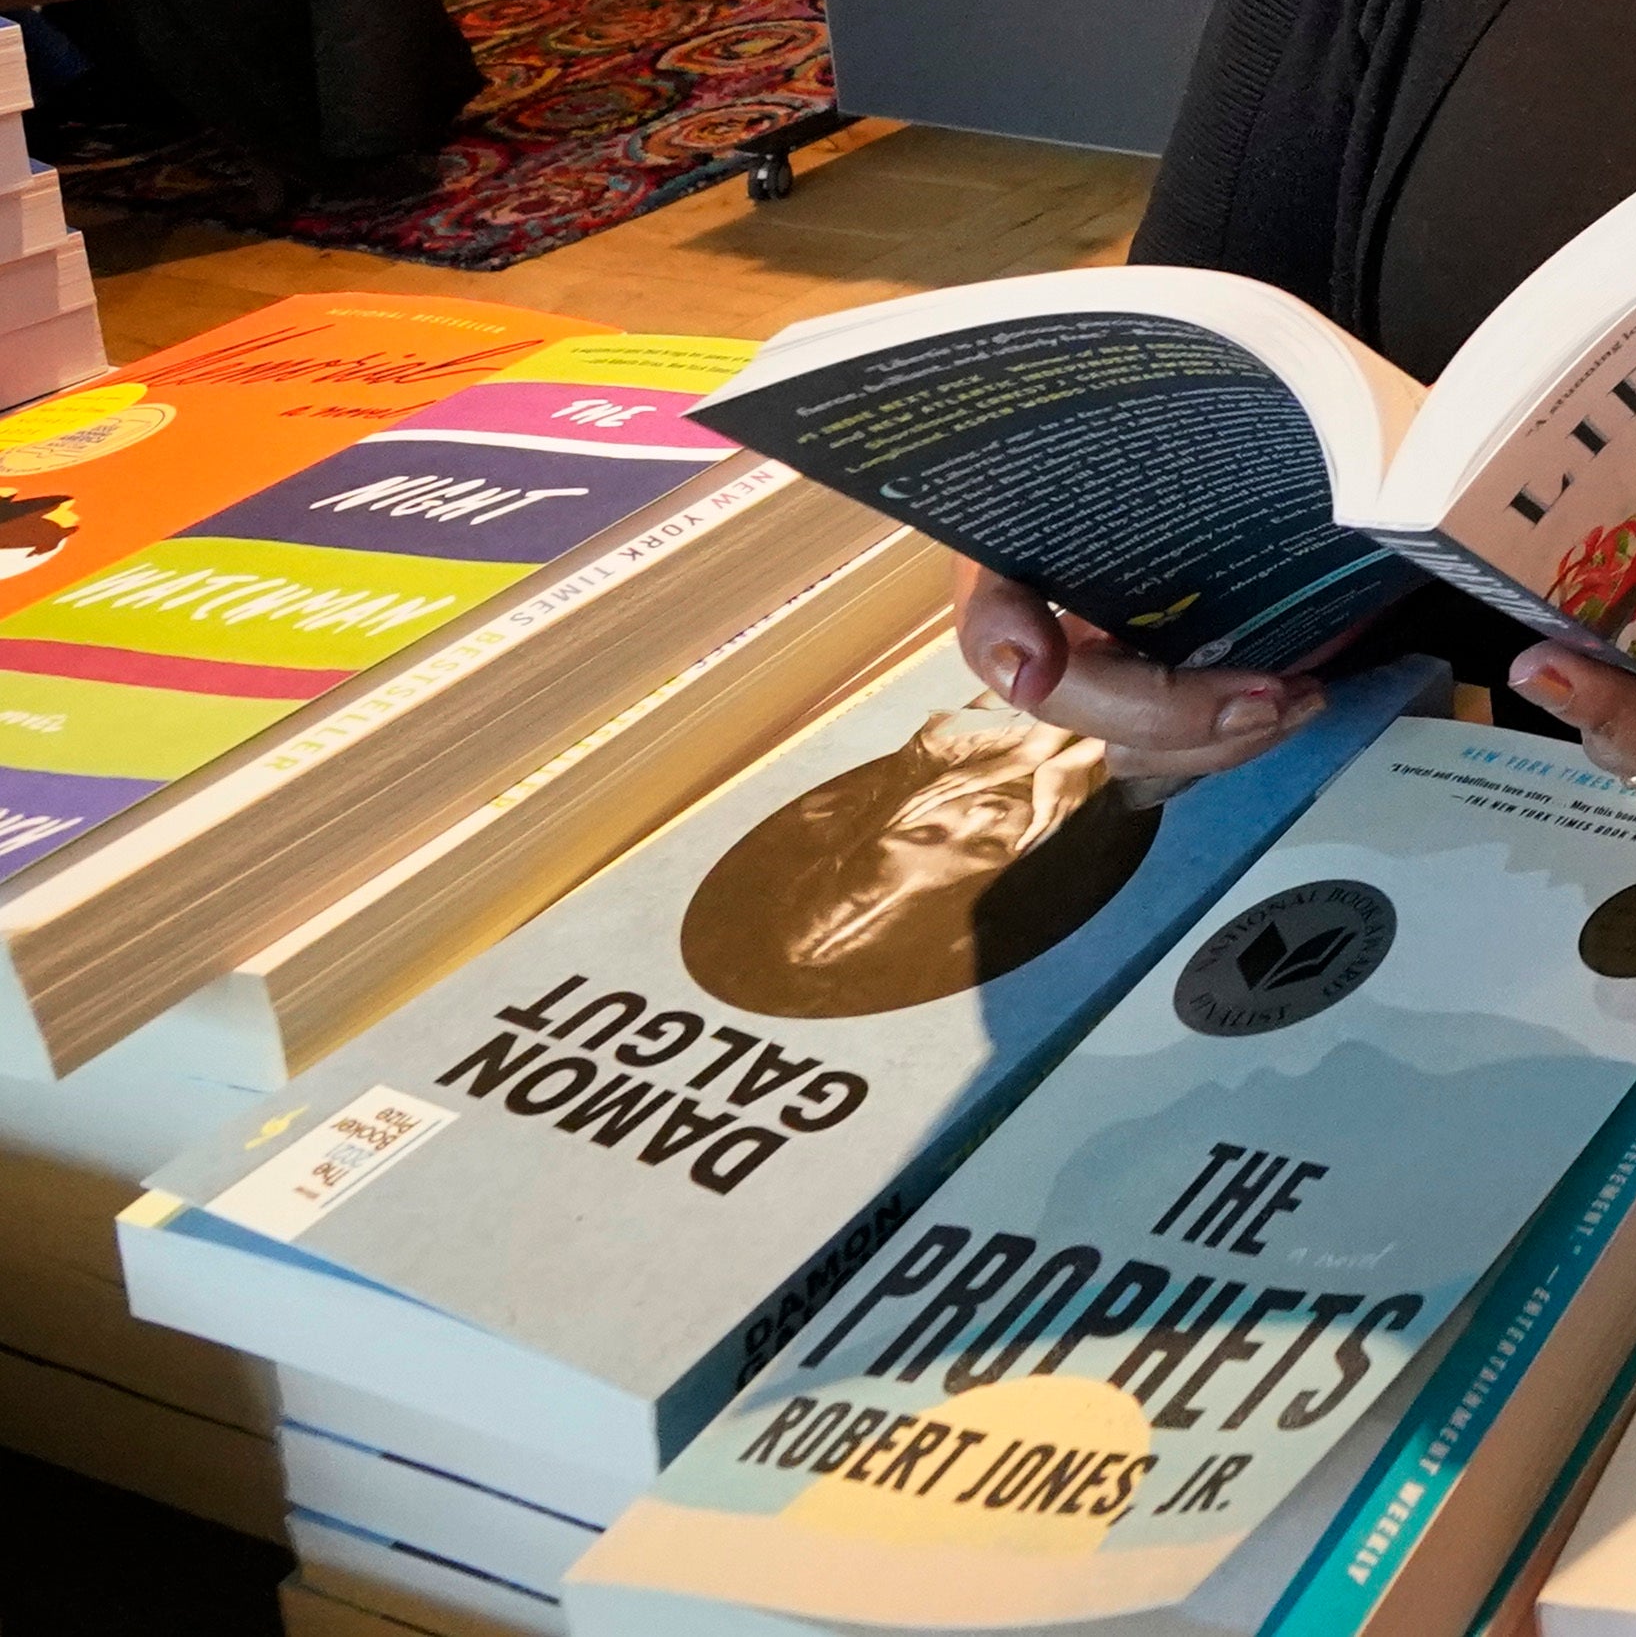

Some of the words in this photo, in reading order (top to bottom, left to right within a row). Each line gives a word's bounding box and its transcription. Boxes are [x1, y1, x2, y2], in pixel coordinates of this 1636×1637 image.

[329, 305, 409, 325] NATIONAL
[416, 311, 508, 336] BESTSELLER
[550, 398, 658, 430] THE
[309, 475, 589, 527] NIGHT
[622, 512, 707, 567] YORK
[52, 561, 461, 640] WATCHMAN
[511, 564, 616, 630] TIMES
[263, 629, 504, 776] BESTSELLER
[492, 973, 871, 1133] GALGUT
[434, 1031, 791, 1197] DAMON
[1151, 1140, 1331, 1260] THE
[798, 1223, 1425, 1433] PROPHETS
[737, 1396, 975, 1499] ROBERT
[962, 1440, 1159, 1528] JONES,
